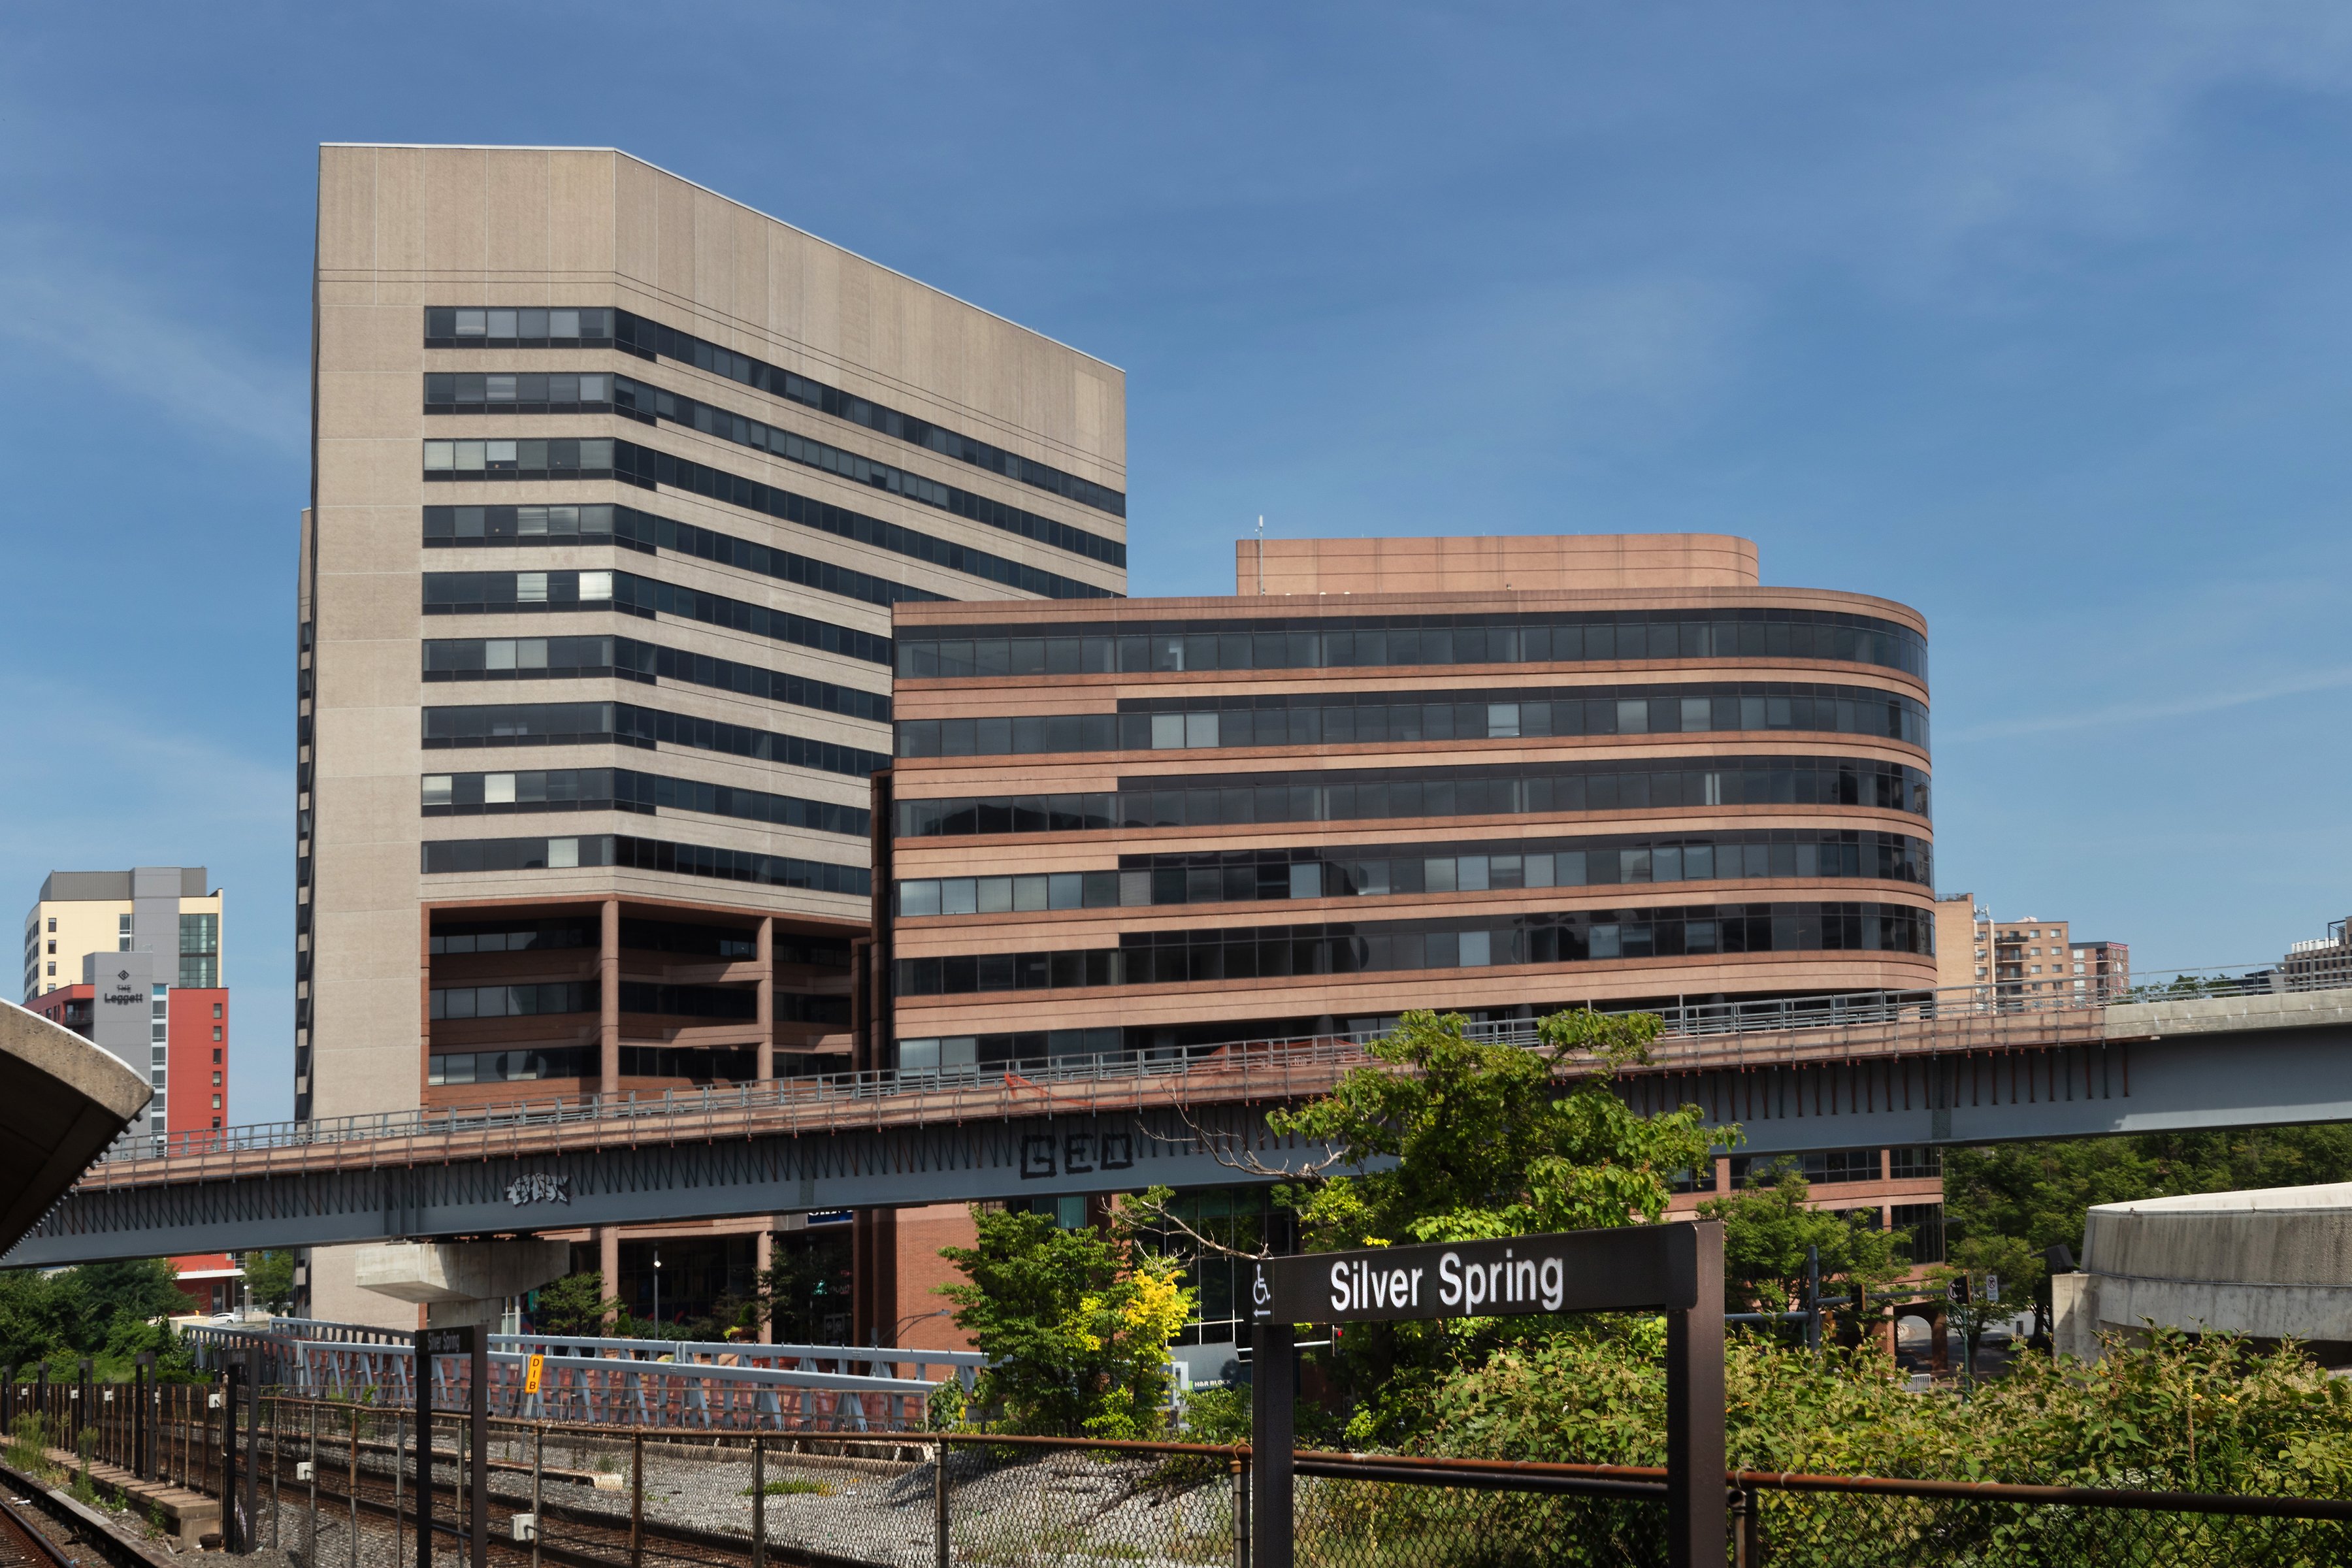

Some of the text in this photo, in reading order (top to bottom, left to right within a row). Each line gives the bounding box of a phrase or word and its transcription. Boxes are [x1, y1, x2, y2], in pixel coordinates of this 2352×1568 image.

[105, 993, 143, 1005] Leggett
[117, 985, 131, 993] THE
[1330, 1248, 1563, 1315] Silver Spring
[529, 1358, 540, 1390] DIB
